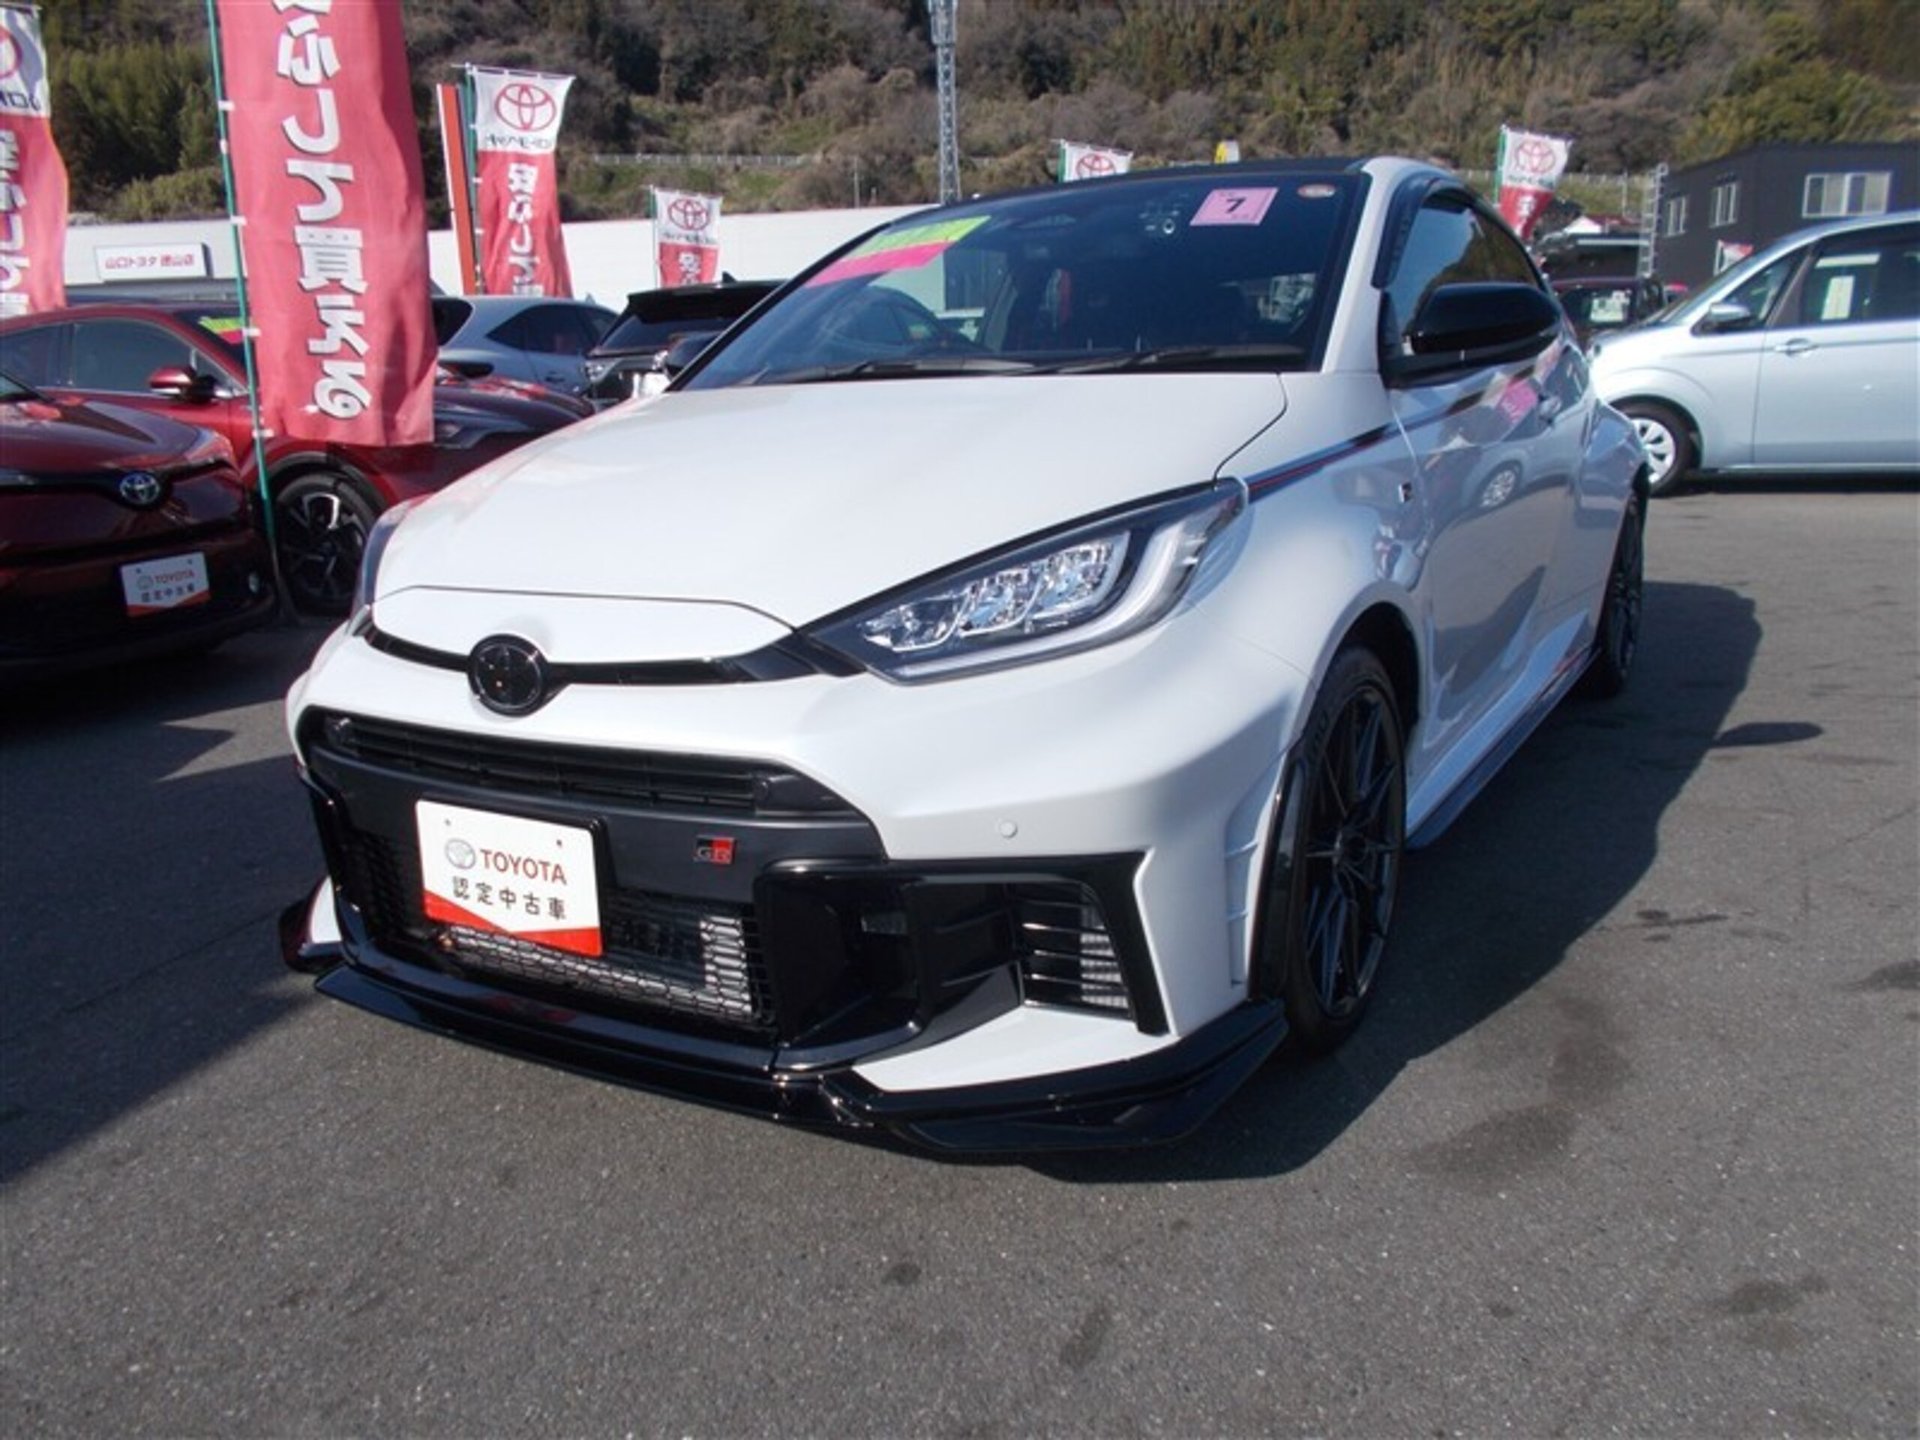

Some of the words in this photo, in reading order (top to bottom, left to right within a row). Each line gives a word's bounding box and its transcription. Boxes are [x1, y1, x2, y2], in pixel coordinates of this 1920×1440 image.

[1225, 197, 1246, 214] 7
[153, 569, 196, 584] TOYOTA
[693, 846, 732, 864] GR
[480, 848, 567, 886] TOYOTA
[452, 875, 567, 920] 認定中古車
